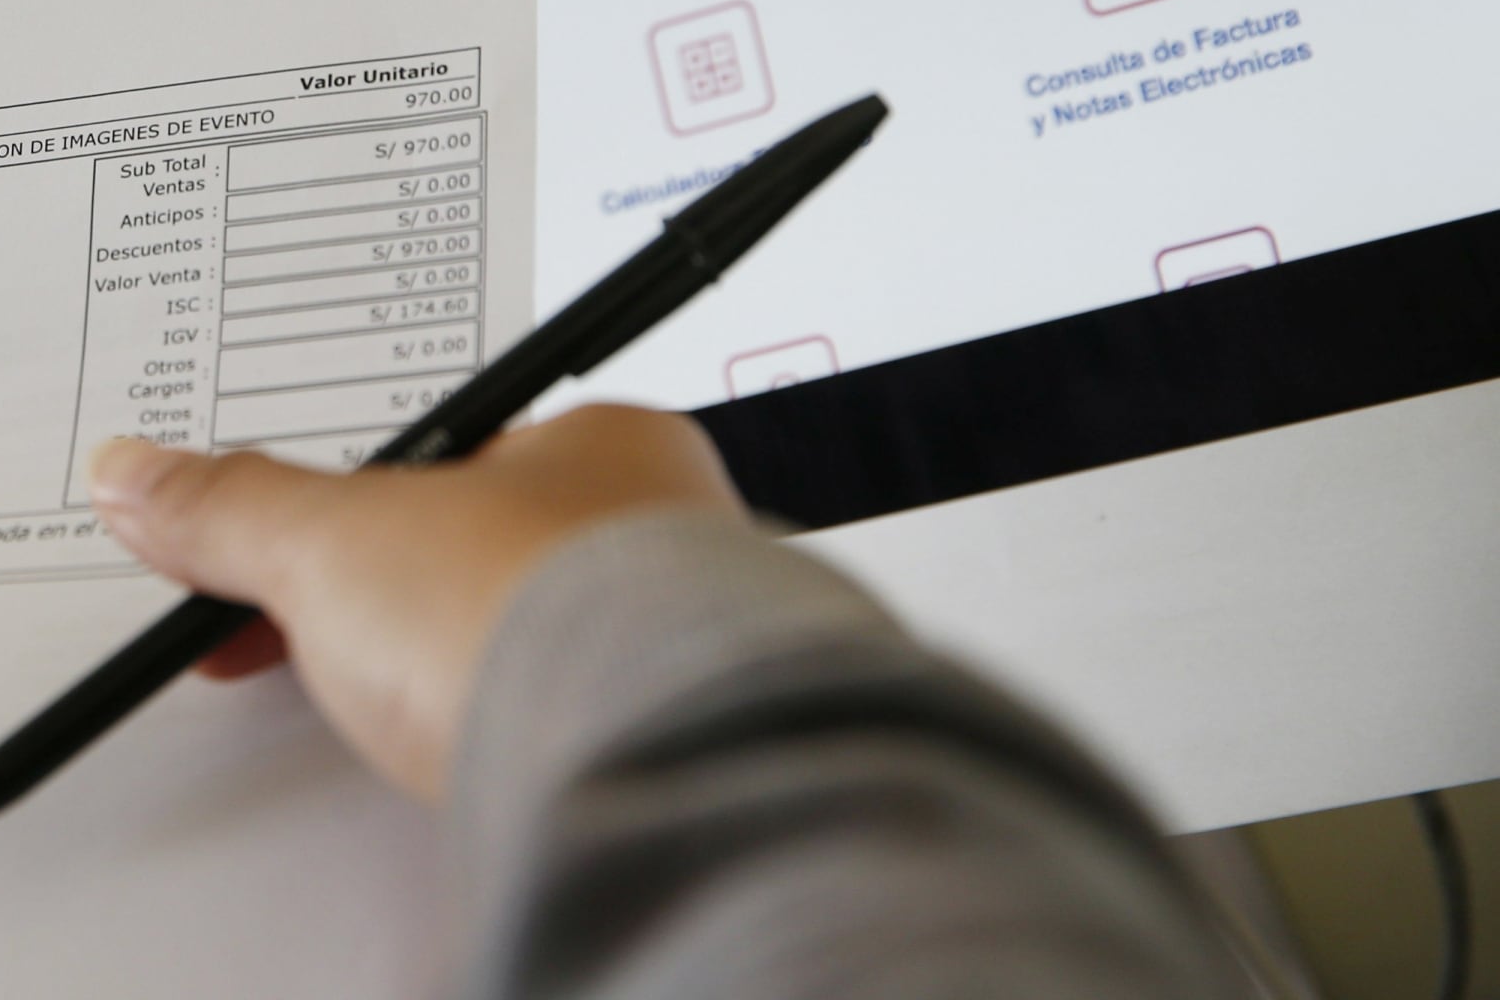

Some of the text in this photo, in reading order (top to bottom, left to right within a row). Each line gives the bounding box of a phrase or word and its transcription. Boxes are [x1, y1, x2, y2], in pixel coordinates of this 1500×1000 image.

[1025, 7, 1301, 98] Consulta de Factura
[300, 71, 357, 91] Valor
[362, 61, 448, 85] Unitario
[1032, 41, 1313, 138] y Notas Electrónicas
[31, 137, 56, 155] DE
[62, 123, 160, 150] IMAGENES
[167, 117, 192, 135] DE
[199, 109, 276, 131] EVENTO
[405, 86, 473, 109] 970.00
[375, 132, 472, 160] S/ 970.00
[120, 154, 207, 179] Sub Total
[143, 177, 206, 197] Ventas
[398, 173, 471, 198] S/ 0.00
[120, 205, 204, 229] Anticipos
[397, 204, 471, 228] S/ 0.00
[96, 235, 203, 262] Descuentos
[372, 235, 471, 261] S/ 970.00
[95, 268, 201, 293] Valor Venta
[396, 266, 470, 290] S/ 0.00
[166, 298, 200, 315] ISC
[370, 296, 469, 323] S/ 174.60
[163, 328, 199, 346] IGV
[422, 336, 467, 357] 0.00
[144, 358, 196, 376] Otros
[128, 379, 194, 401] Cargos
[139, 406, 191, 425] Otros
[38, 524, 68, 539] en
